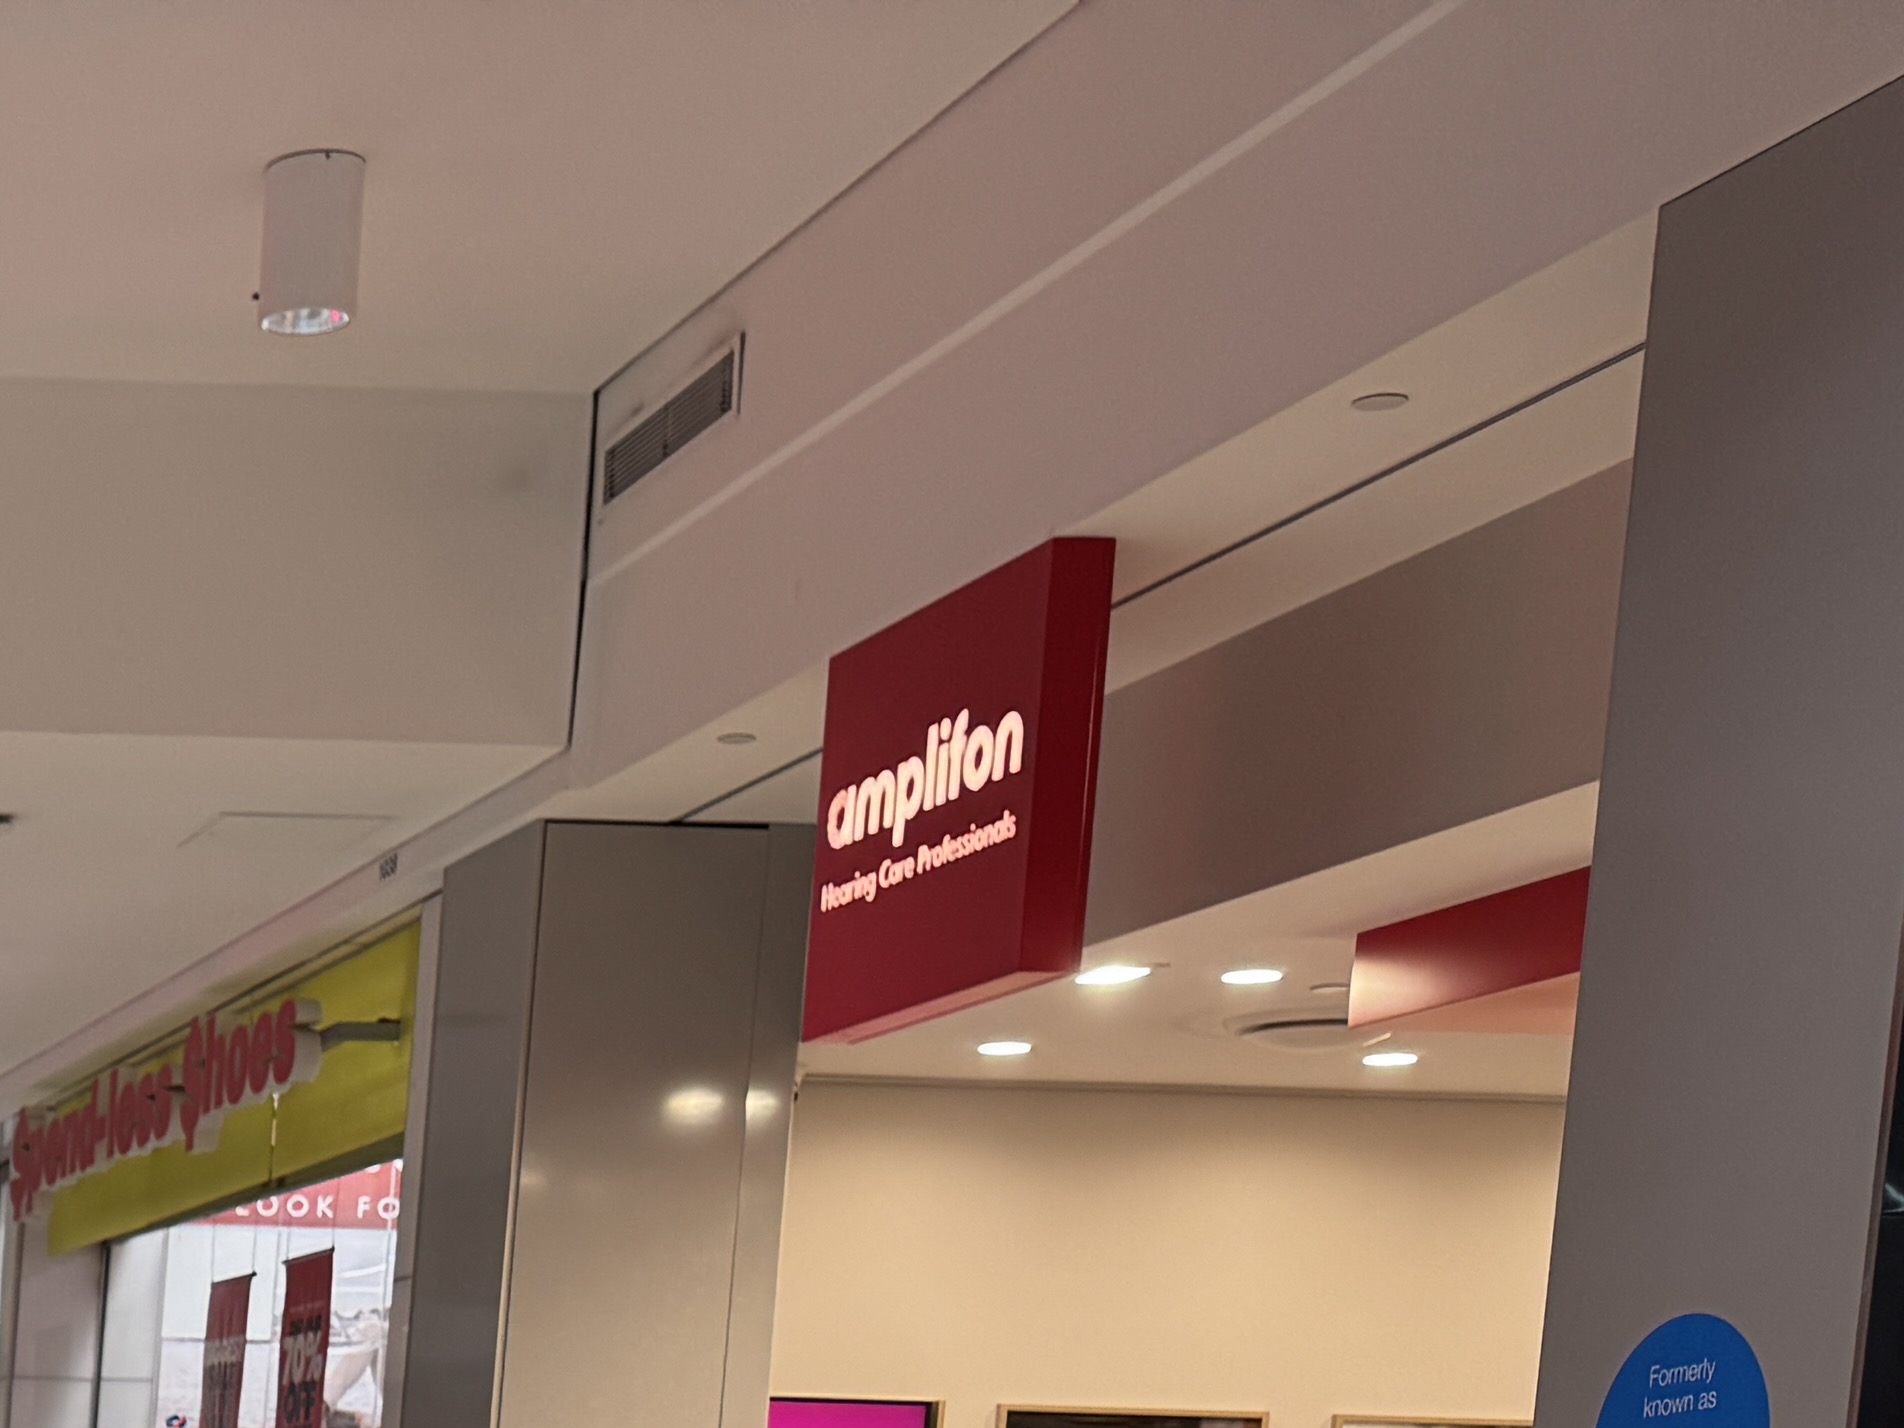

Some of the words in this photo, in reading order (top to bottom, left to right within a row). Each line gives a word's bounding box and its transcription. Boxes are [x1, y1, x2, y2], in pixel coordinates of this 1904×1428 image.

[827, 709, 1024, 849] amplifon
[821, 871, 877, 912] Hearing
[879, 856, 915, 888] Care
[917, 809, 1017, 874] Professionals
[1643, 1394, 1694, 1419] known
[1698, 1391, 1717, 1410] as
[1648, 1357, 1716, 1389] Formerly
